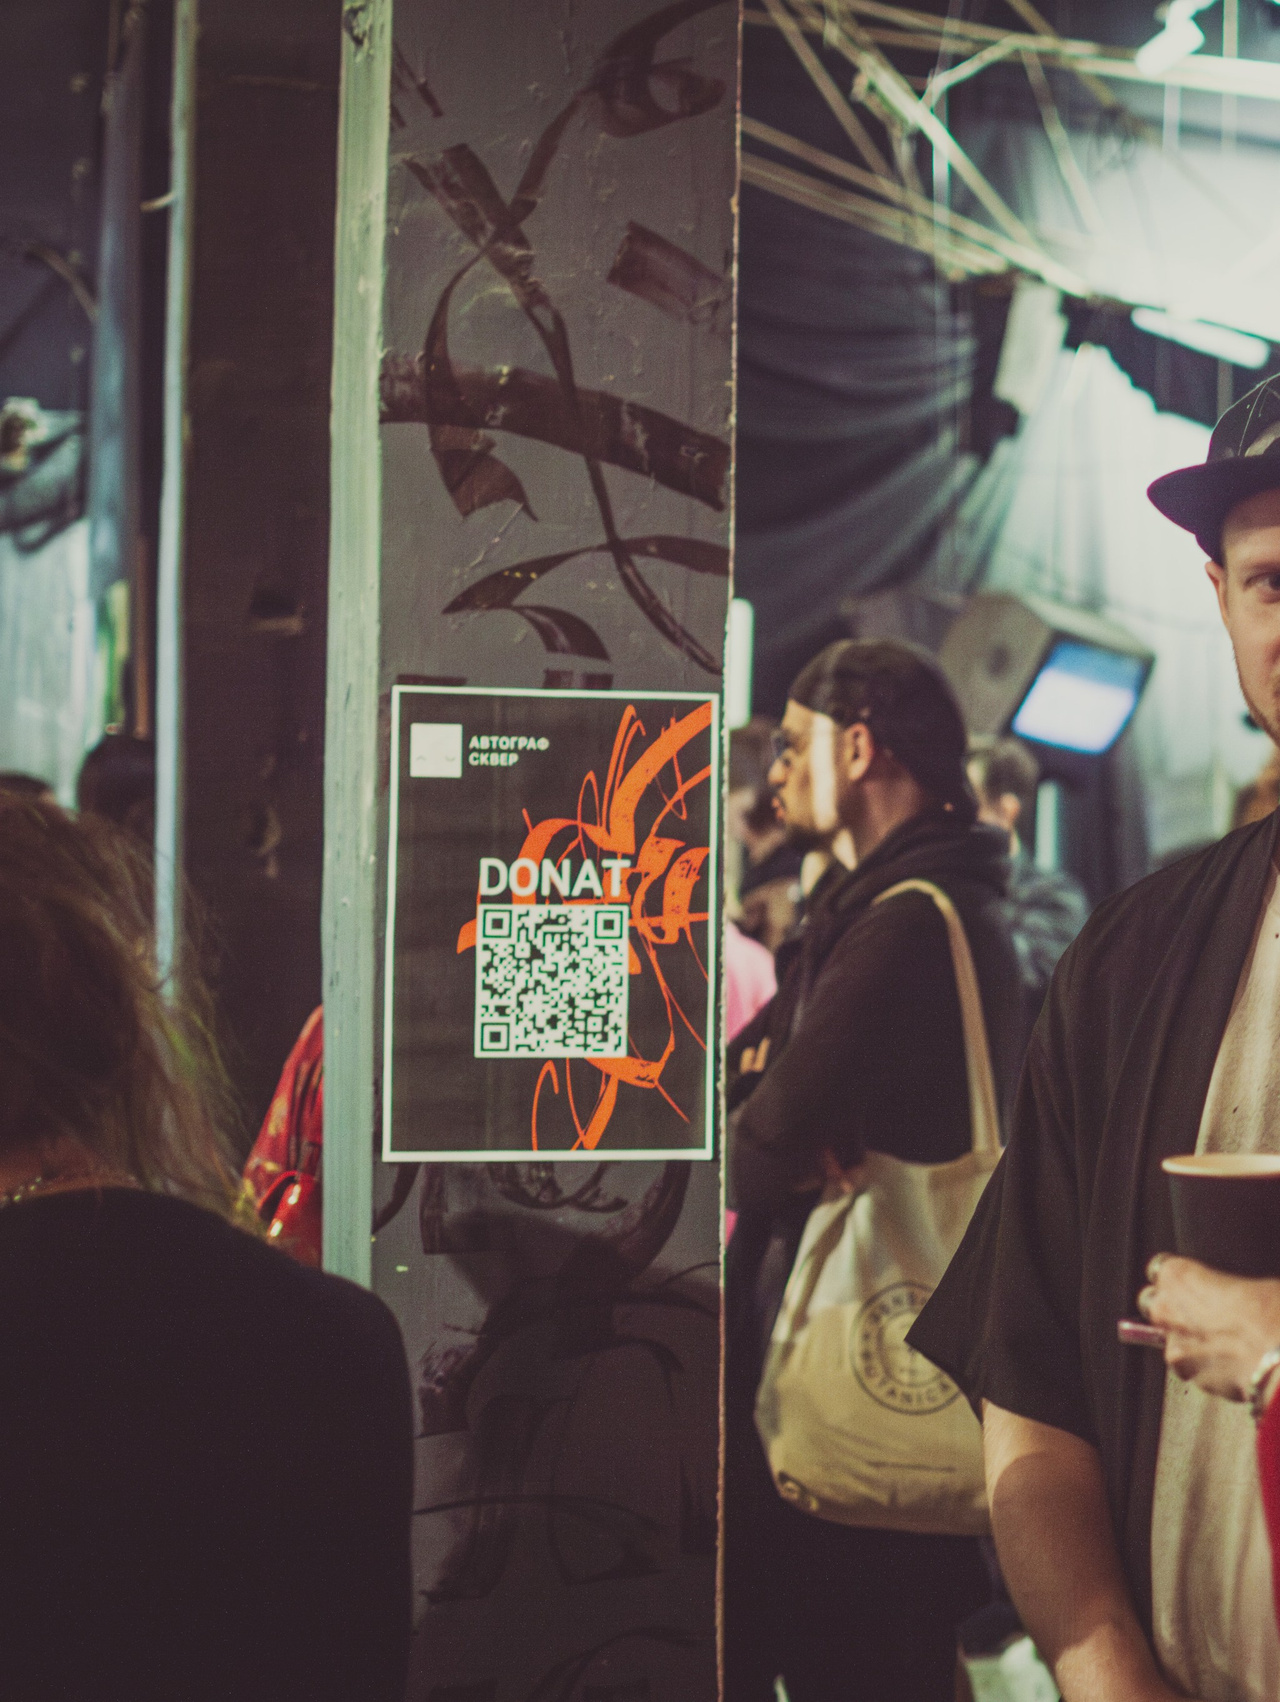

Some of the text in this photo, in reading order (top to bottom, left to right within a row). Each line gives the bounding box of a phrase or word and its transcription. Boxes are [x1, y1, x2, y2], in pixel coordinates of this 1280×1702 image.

[469, 735, 550, 751] АВТОГРАФ
[469, 752, 519, 767] СКВЕР
[479, 857, 632, 897] DONAT
